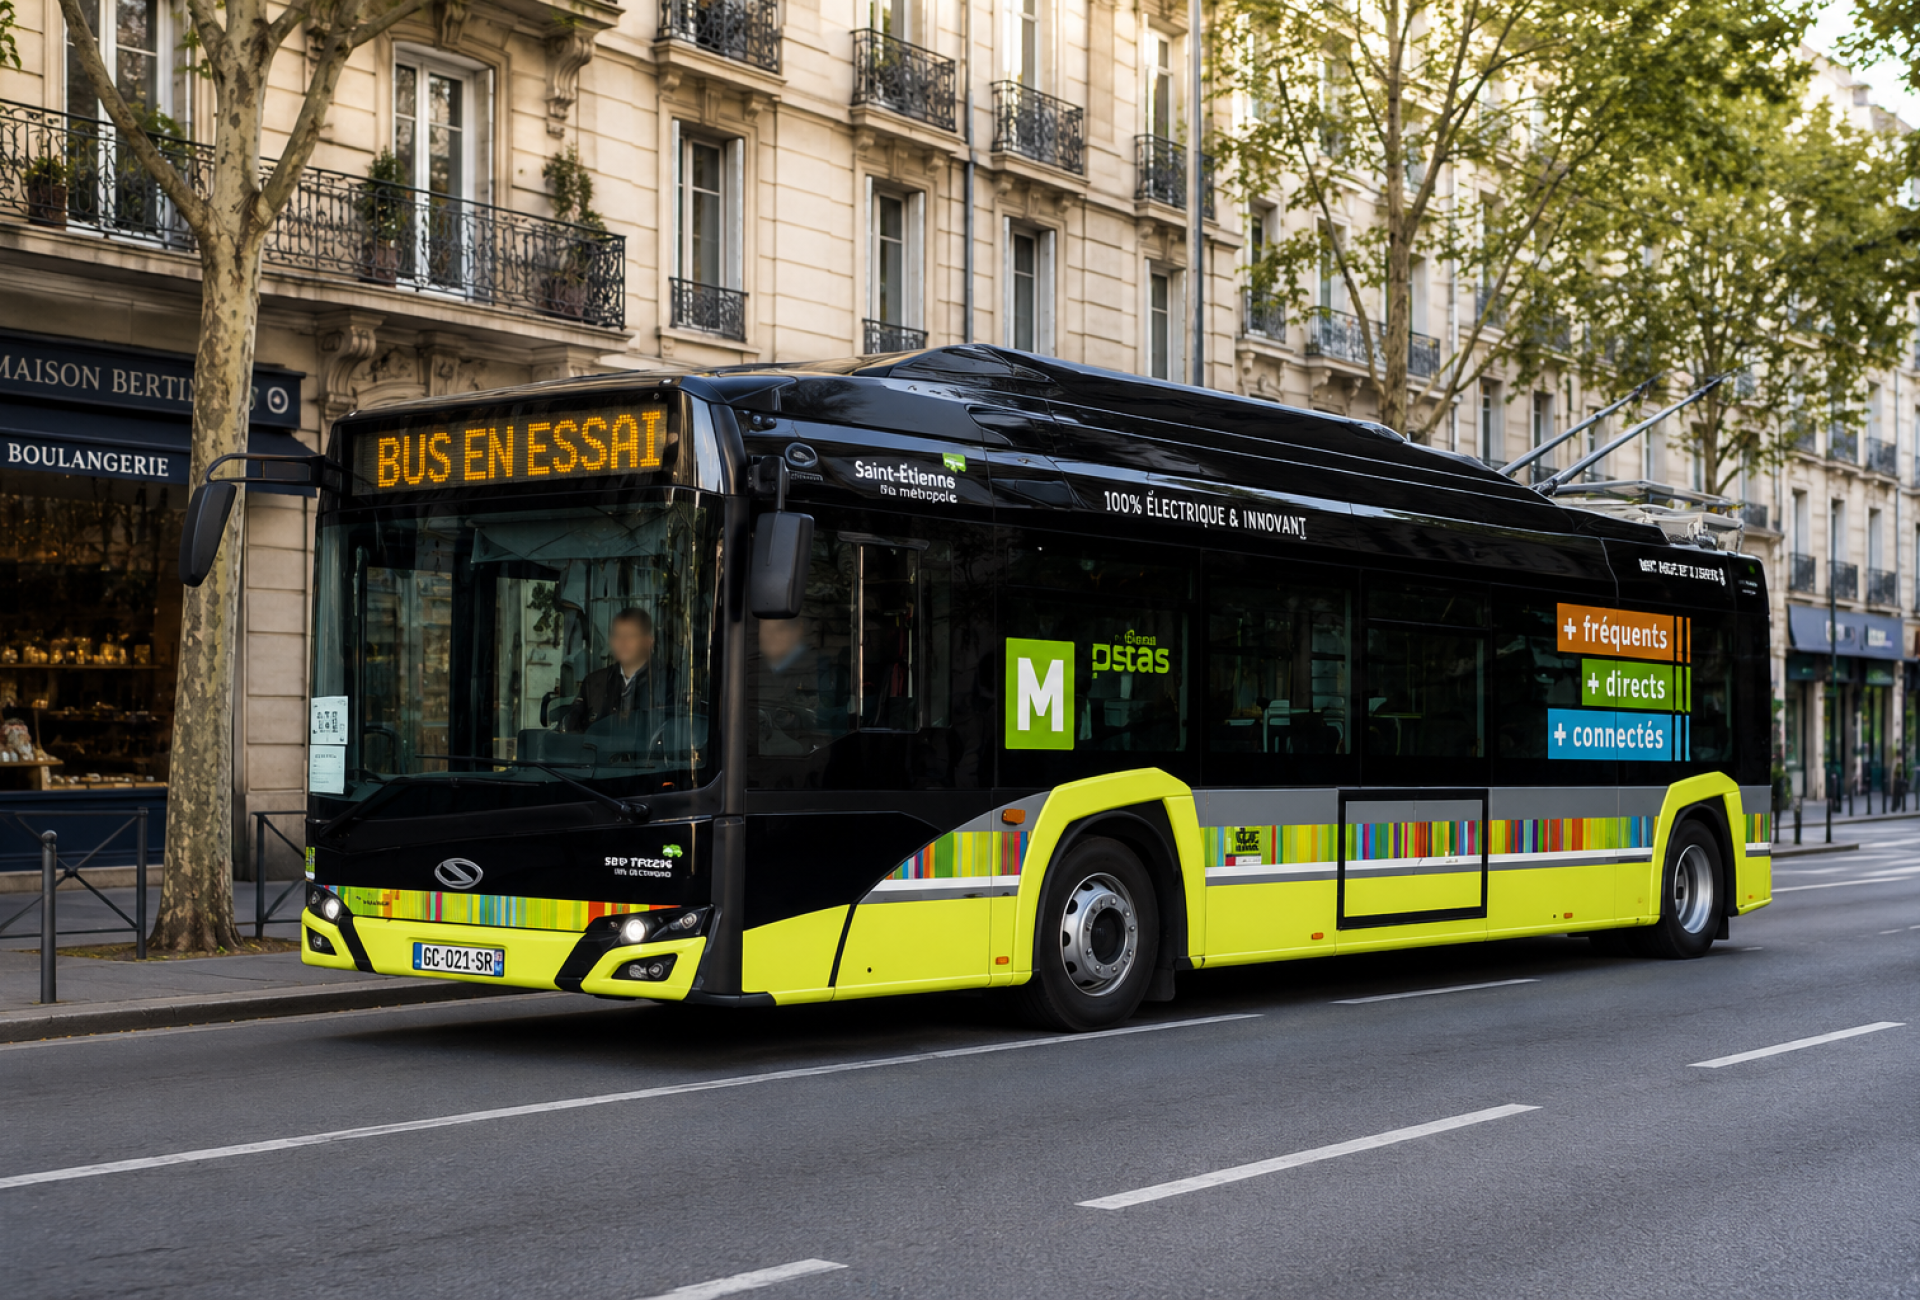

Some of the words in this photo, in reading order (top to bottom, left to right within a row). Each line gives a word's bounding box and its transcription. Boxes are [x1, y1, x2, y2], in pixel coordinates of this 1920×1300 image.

[8, 443, 169, 477] BOULANGERIE
[377, 431, 452, 488] BUS
[464, 426, 514, 482] EN
[527, 409, 662, 477] ESSAI
[1104, 491, 1143, 515] 100%
[1147, 490, 1226, 528] ÉLECTRIQUE
[1229, 508, 1239, 528] &
[1243, 510, 1307, 540] INNOVANT
[1583, 615, 1668, 652] fréquents
[1017, 657, 1064, 732] M
[1606, 670, 1666, 699] directs
[1573, 720, 1663, 749] connectés
[423, 946, 493, 972] GC-021-SR
